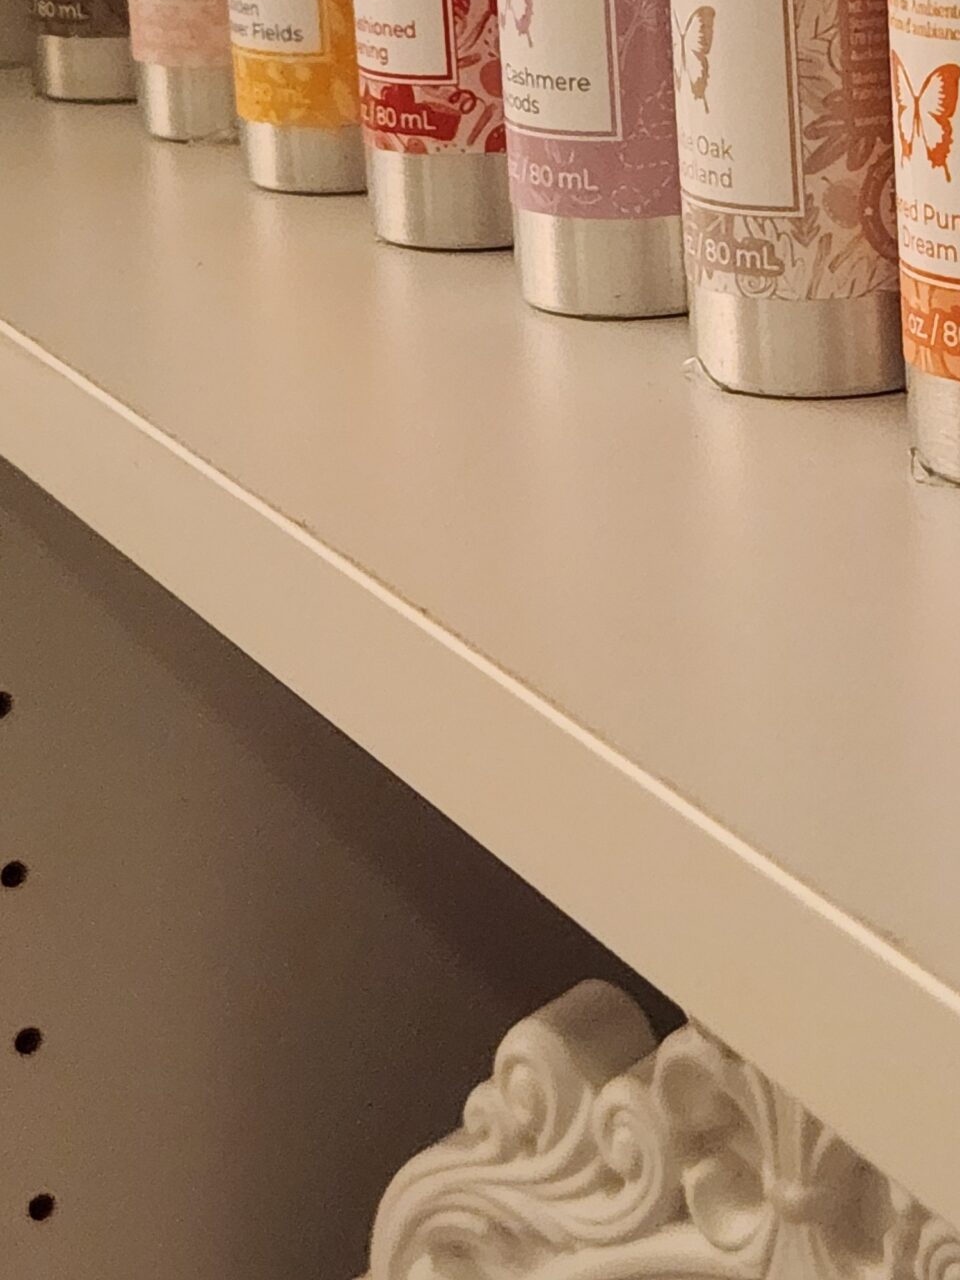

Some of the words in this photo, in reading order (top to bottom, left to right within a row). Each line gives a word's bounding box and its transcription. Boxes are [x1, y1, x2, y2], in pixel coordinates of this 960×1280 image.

[252, 22, 305, 43] Fields
[505, 62, 591, 92] Cashmere
[400, 110, 438, 130] mL
[697, 135, 735, 162] Oak
[558, 168, 600, 191] mL
[902, 224, 958, 263] Dream
[736, 246, 781, 272] mL
